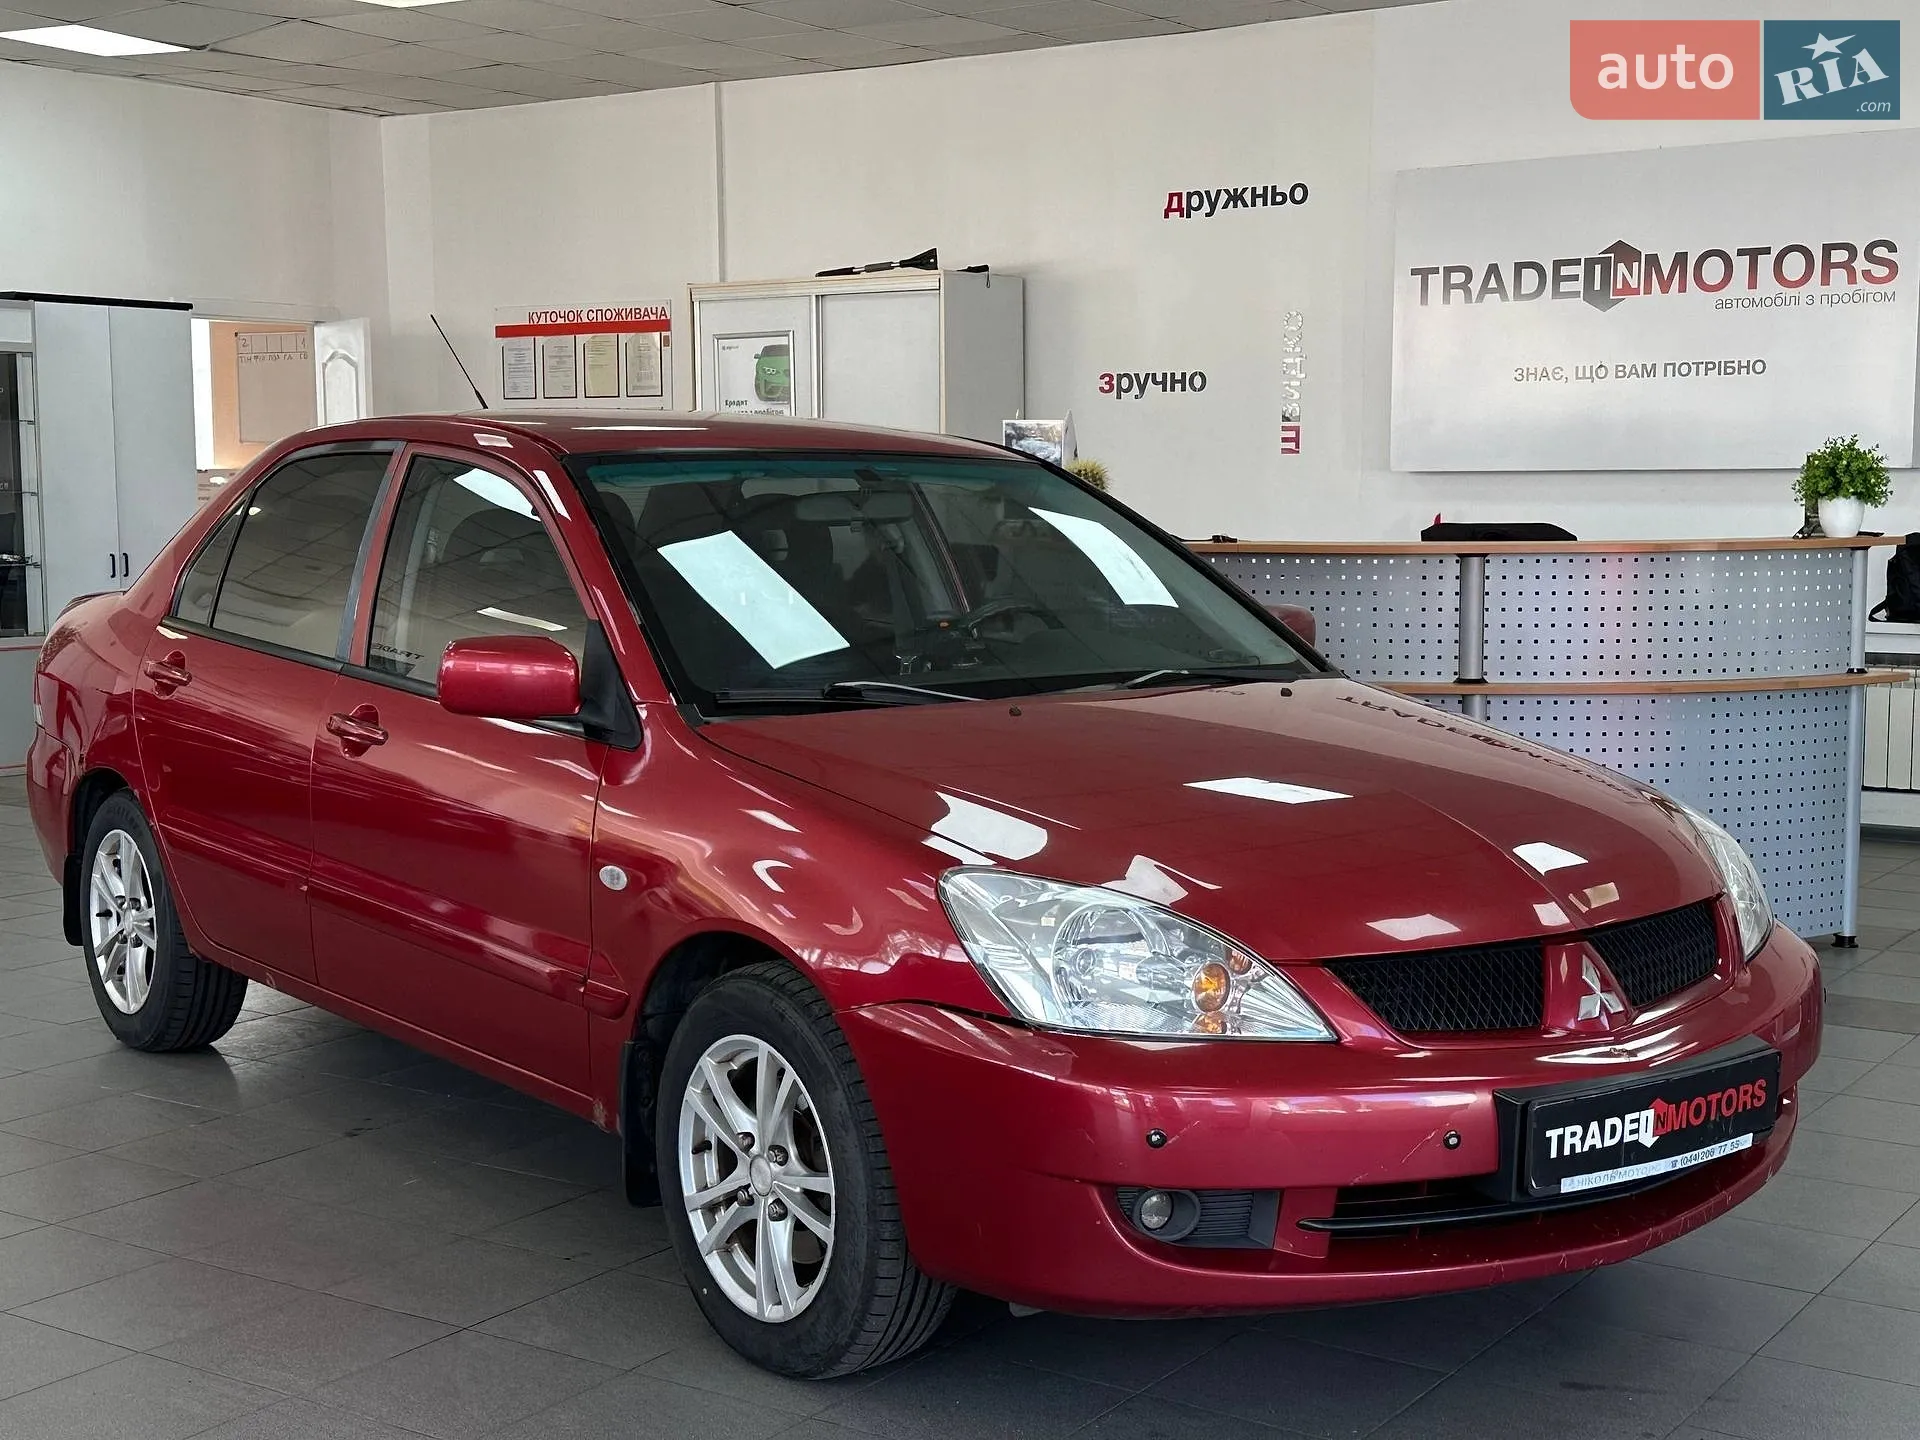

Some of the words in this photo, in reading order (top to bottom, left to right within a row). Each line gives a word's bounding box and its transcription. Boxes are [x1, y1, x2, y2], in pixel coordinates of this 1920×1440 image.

[1163, 182, 1309, 219] дружньо
[1715, 291, 1801, 310] автомобілі
[1805, 294, 1815, 306] з
[1820, 288, 1897, 308] пробігом
[528, 309, 583, 325] КУТОЧОК
[587, 305, 668, 323] СПОЖИВАЧА
[1513, 366, 1569, 383] ЗНАЄ,
[1575, 363, 1609, 383] ЩО
[1615, 362, 1657, 379] ВАМ
[1663, 358, 1768, 377] ПОТРІБНО
[1098, 370, 1207, 400] зручно
